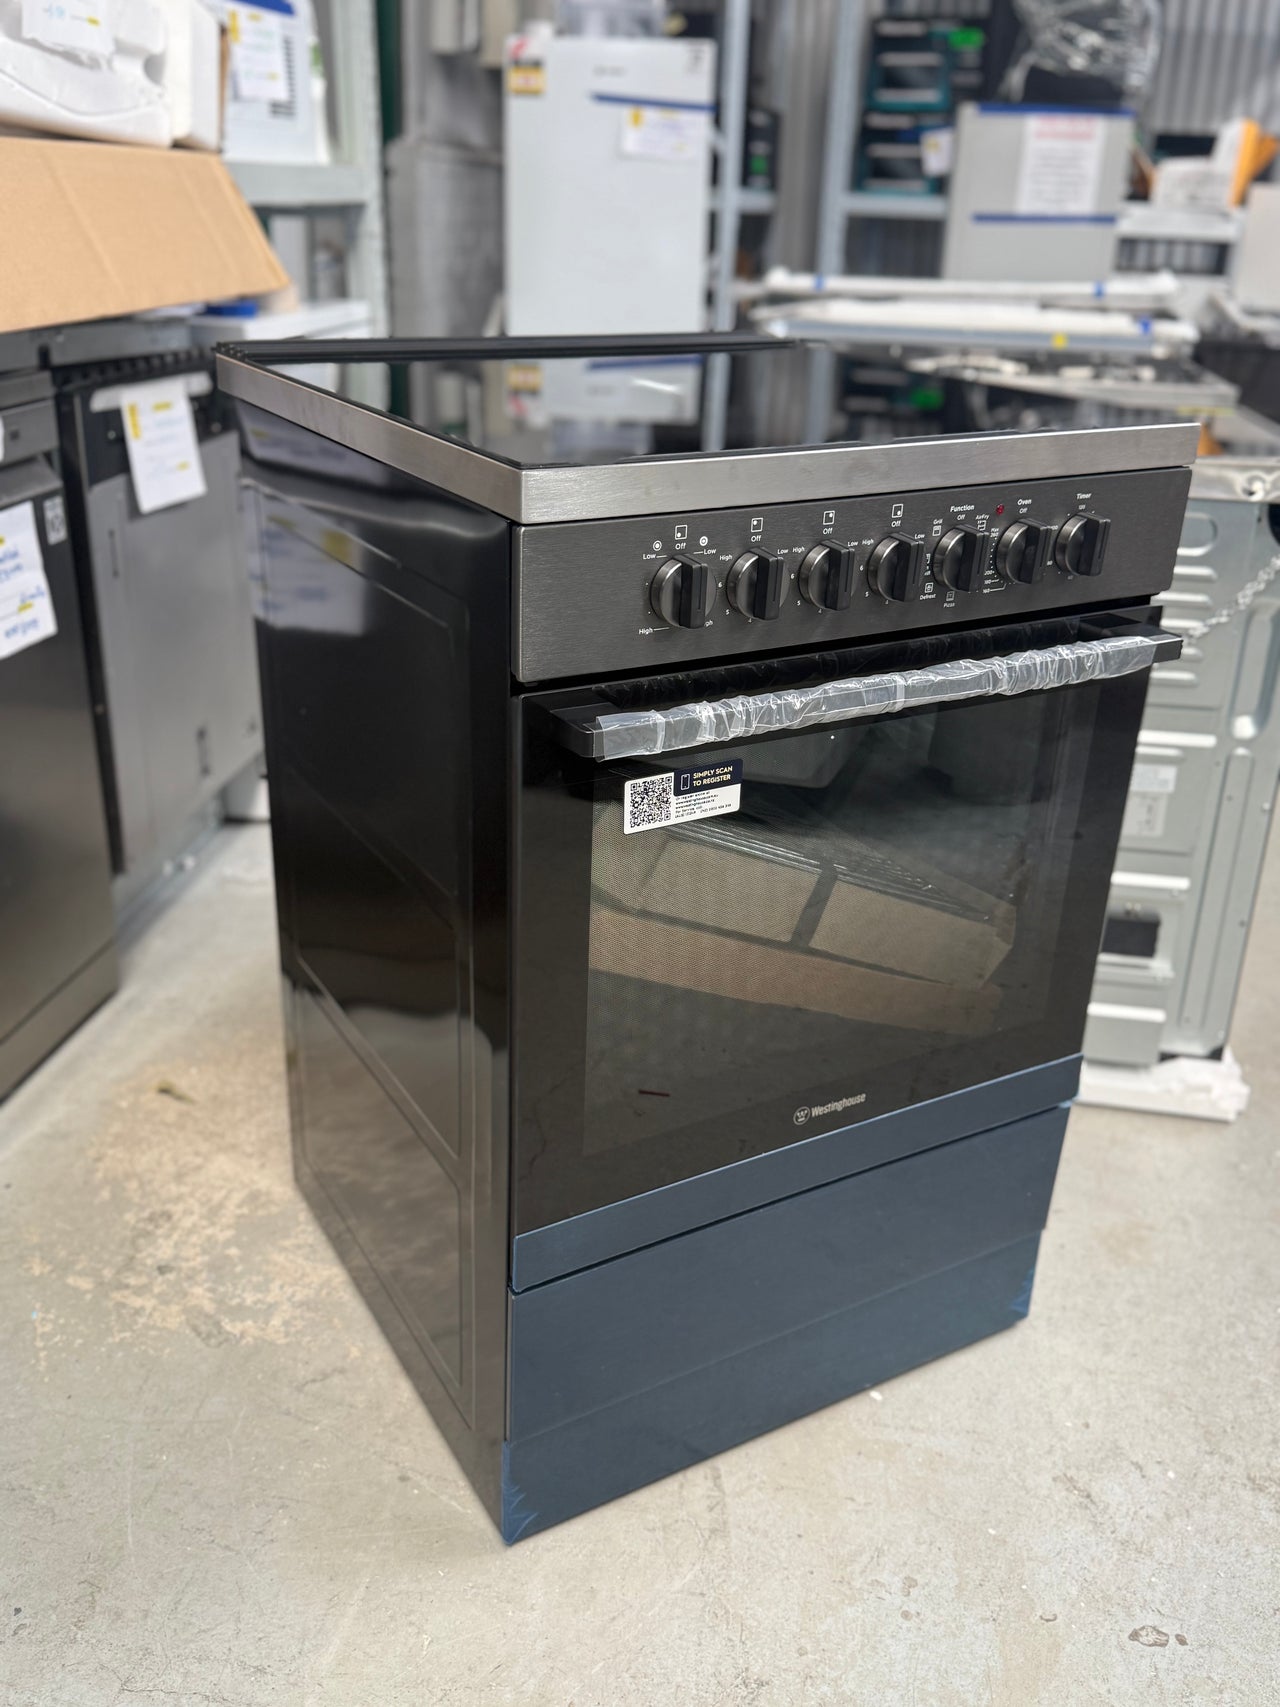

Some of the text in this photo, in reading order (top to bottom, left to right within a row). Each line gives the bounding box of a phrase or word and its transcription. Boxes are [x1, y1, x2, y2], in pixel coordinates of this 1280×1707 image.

[1076, 492, 1092, 500] Timer
[1017, 498, 1032, 506] Oven
[950, 504, 974, 512] Function
[891, 520, 902, 528] Off
[822, 527, 833, 535] Off
[750, 534, 762, 542] Off
[862, 538, 874, 546] High
[675, 542, 687, 550] Off
[792, 546, 805, 554] High
[703, 548, 717, 556] Low
[719, 554, 733, 562] High
[638, 627, 654, 635] High
[693, 766, 733, 779] SIMPLY SCAN
[702, 773, 731, 785] REGISTER
[811, 1093, 867, 1118] Westinghouse
